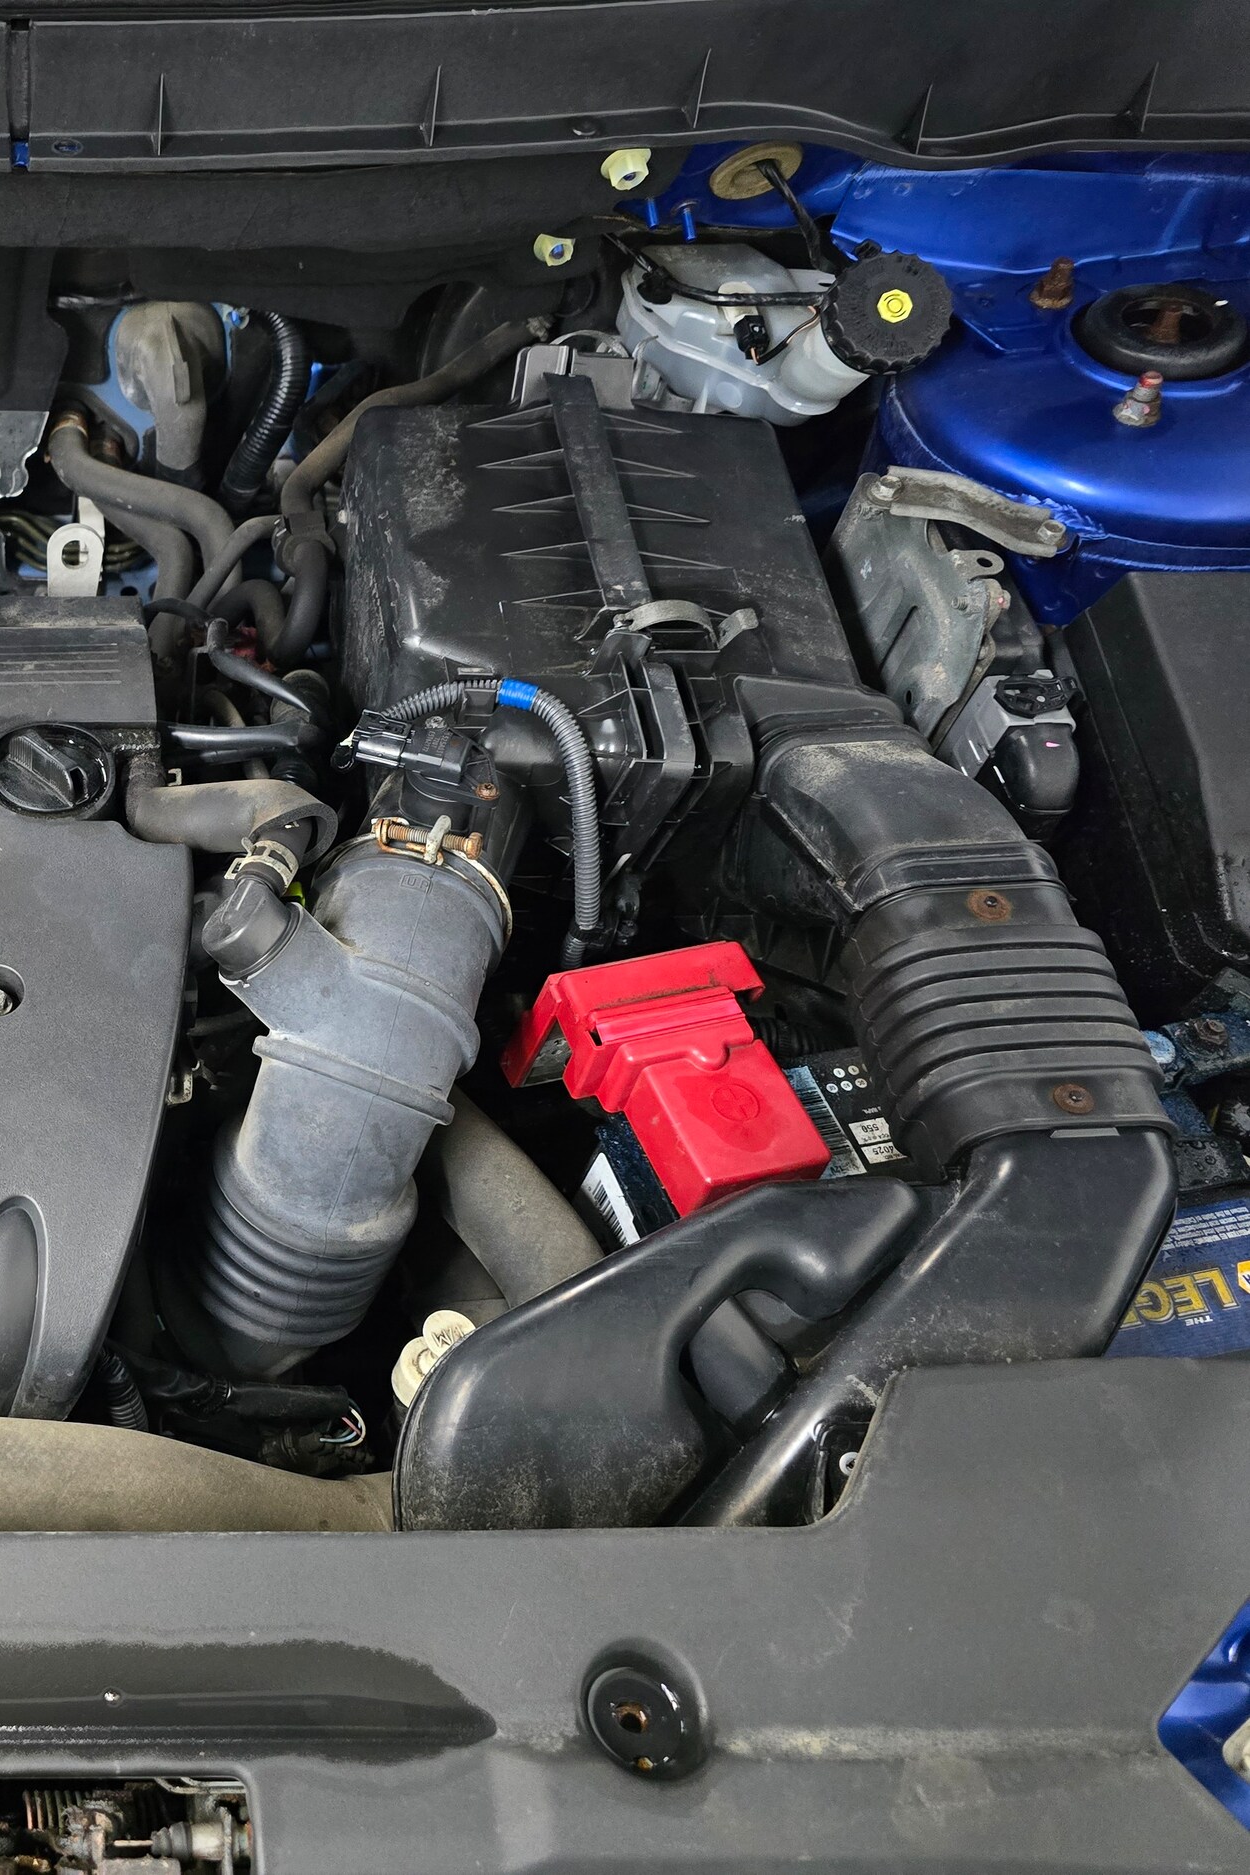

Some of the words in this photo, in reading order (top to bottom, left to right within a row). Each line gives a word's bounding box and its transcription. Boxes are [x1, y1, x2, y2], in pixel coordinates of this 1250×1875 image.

[861, 1124, 879, 1133] 550
[872, 1145, 894, 1155] 4025
[1119, 1268, 1241, 1331] LEG
[1185, 1315, 1213, 1327] THE
